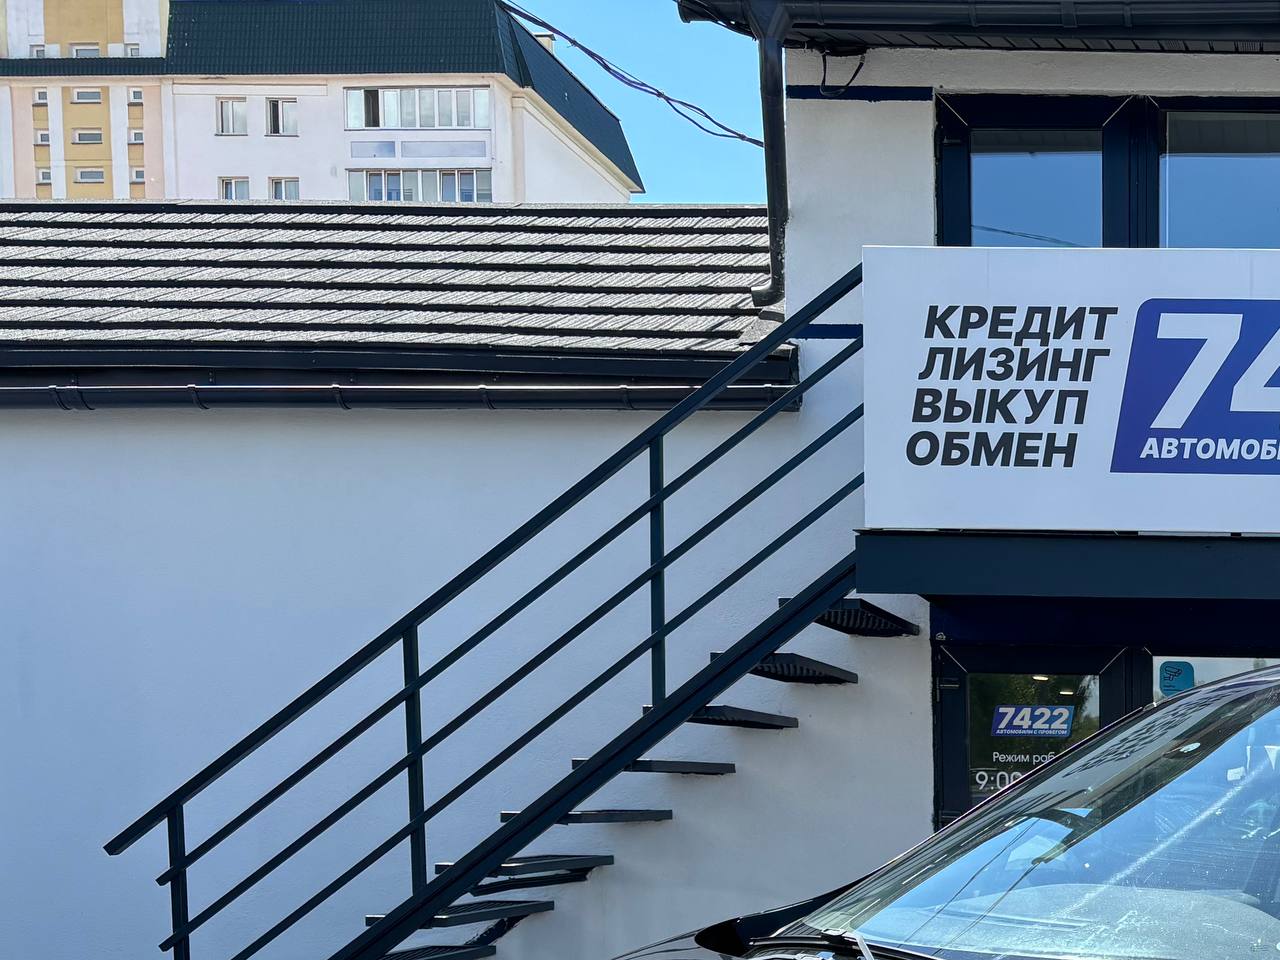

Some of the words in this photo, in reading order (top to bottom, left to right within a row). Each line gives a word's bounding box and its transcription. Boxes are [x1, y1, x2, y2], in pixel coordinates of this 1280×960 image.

[924, 305, 1118, 346] КРЕДИТ
[918, 347, 1110, 382] ЛИЗИНГ
[912, 388, 1089, 424] ВЫКУП
[906, 431, 1078, 467] ОБМЕН
[998, 707, 1070, 730] 7422
[992, 751, 1030, 763] Режим
